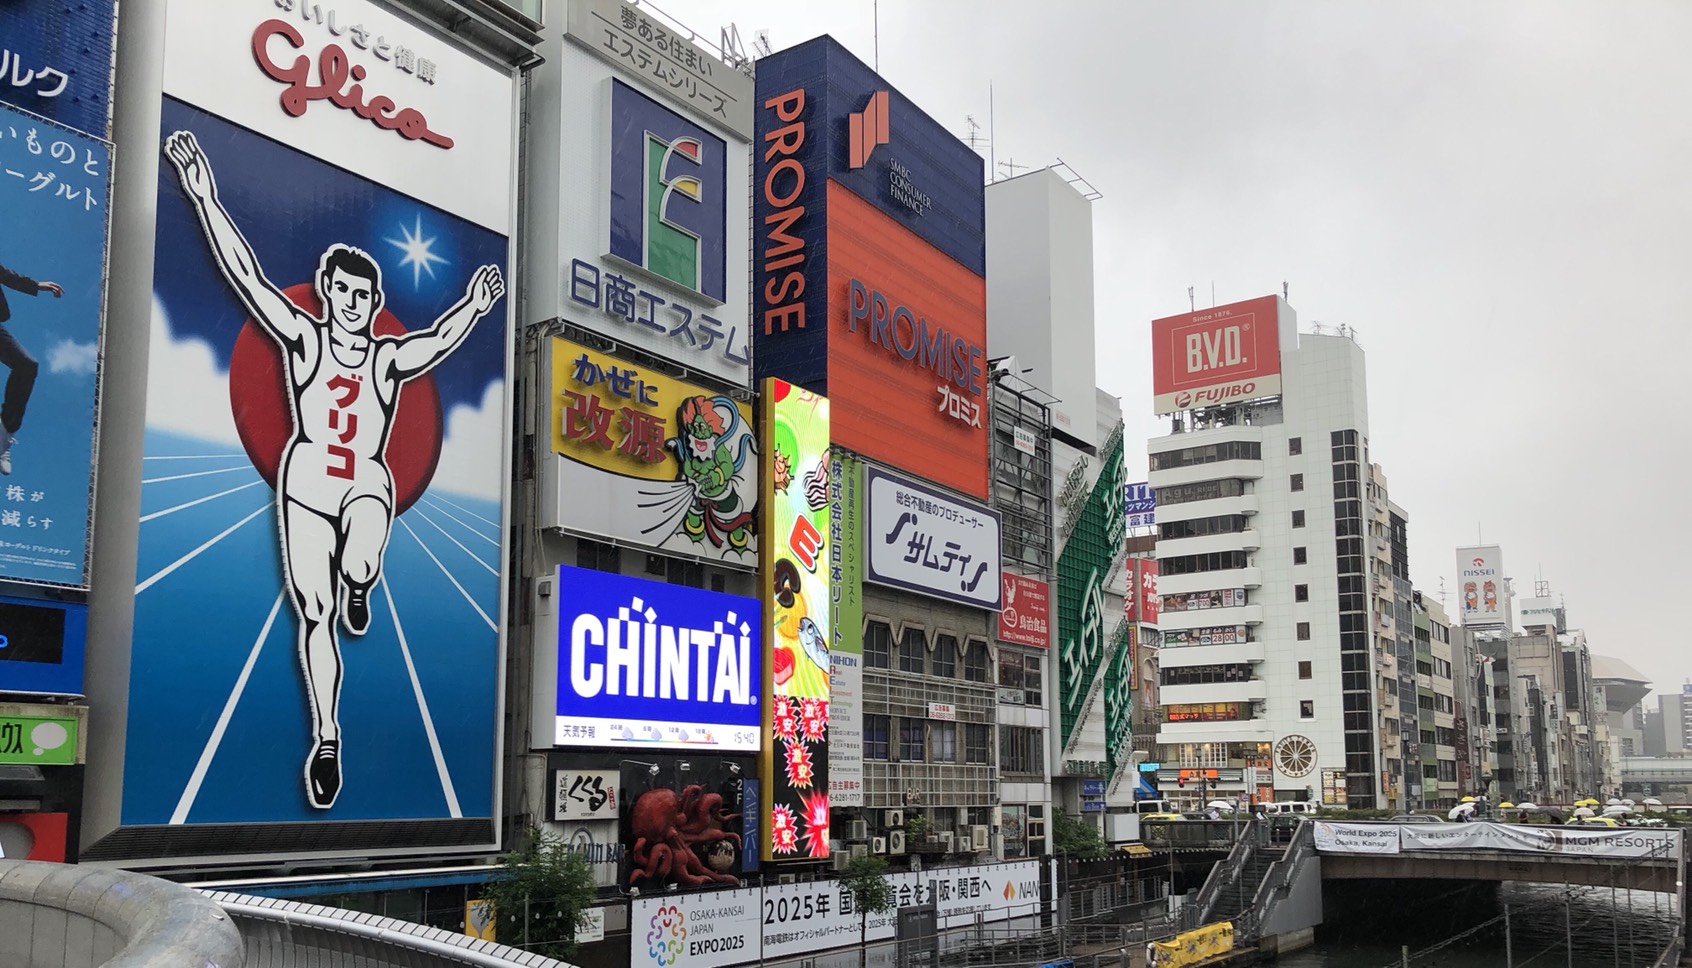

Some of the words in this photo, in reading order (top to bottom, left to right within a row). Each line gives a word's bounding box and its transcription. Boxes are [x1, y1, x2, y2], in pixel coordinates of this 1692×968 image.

[621, 5, 713, 77] 夢ある住まい
[252, 18, 454, 149] Glico
[604, 28, 727, 119] エステムシリーズ
[889, 157, 912, 182] SMBC
[890, 172, 932, 210] CONSUMER
[890, 184, 924, 217] FINANCE
[764, 88, 806, 336] PROMISE
[571, 258, 750, 366] 日商エステム
[1192, 314, 1212, 323] Since
[849, 277, 983, 396] PROMISE
[1186, 325, 1248, 373] B.V.D.
[572, 353, 659, 407] かぜに
[1194, 382, 1256, 404] FUJIBO
[561, 388, 667, 464] 改源
[936, 384, 982, 429] プロミス
[326, 373, 363, 481] グリコ
[896, 490, 984, 529] 総合不動産のプロデューサー
[903, 531, 972, 577] サムティ
[1463, 568, 1495, 577] NISSEI
[570, 596, 751, 705] CHINTAI
[563, 725, 596, 739] 天気予報
[907, 787, 921, 801] BAR
[1335, 829, 1356, 837] World
[1358, 830, 1378, 838] Expo
[1335, 839, 1359, 847] Osaka,
[1362, 840, 1388, 848] Kansai
[1565, 836, 1600, 846] MGM
[1604, 837, 1675, 848] RESORTS
[690, 905, 745, 922] OSAKA-KANSAI
[764, 892, 830, 924] 2025年
[839, 876, 992, 915] 国覧会を阪・関西へ
[690, 923, 714, 937] JAPAN
[690, 935, 745, 956] EXPO2025
